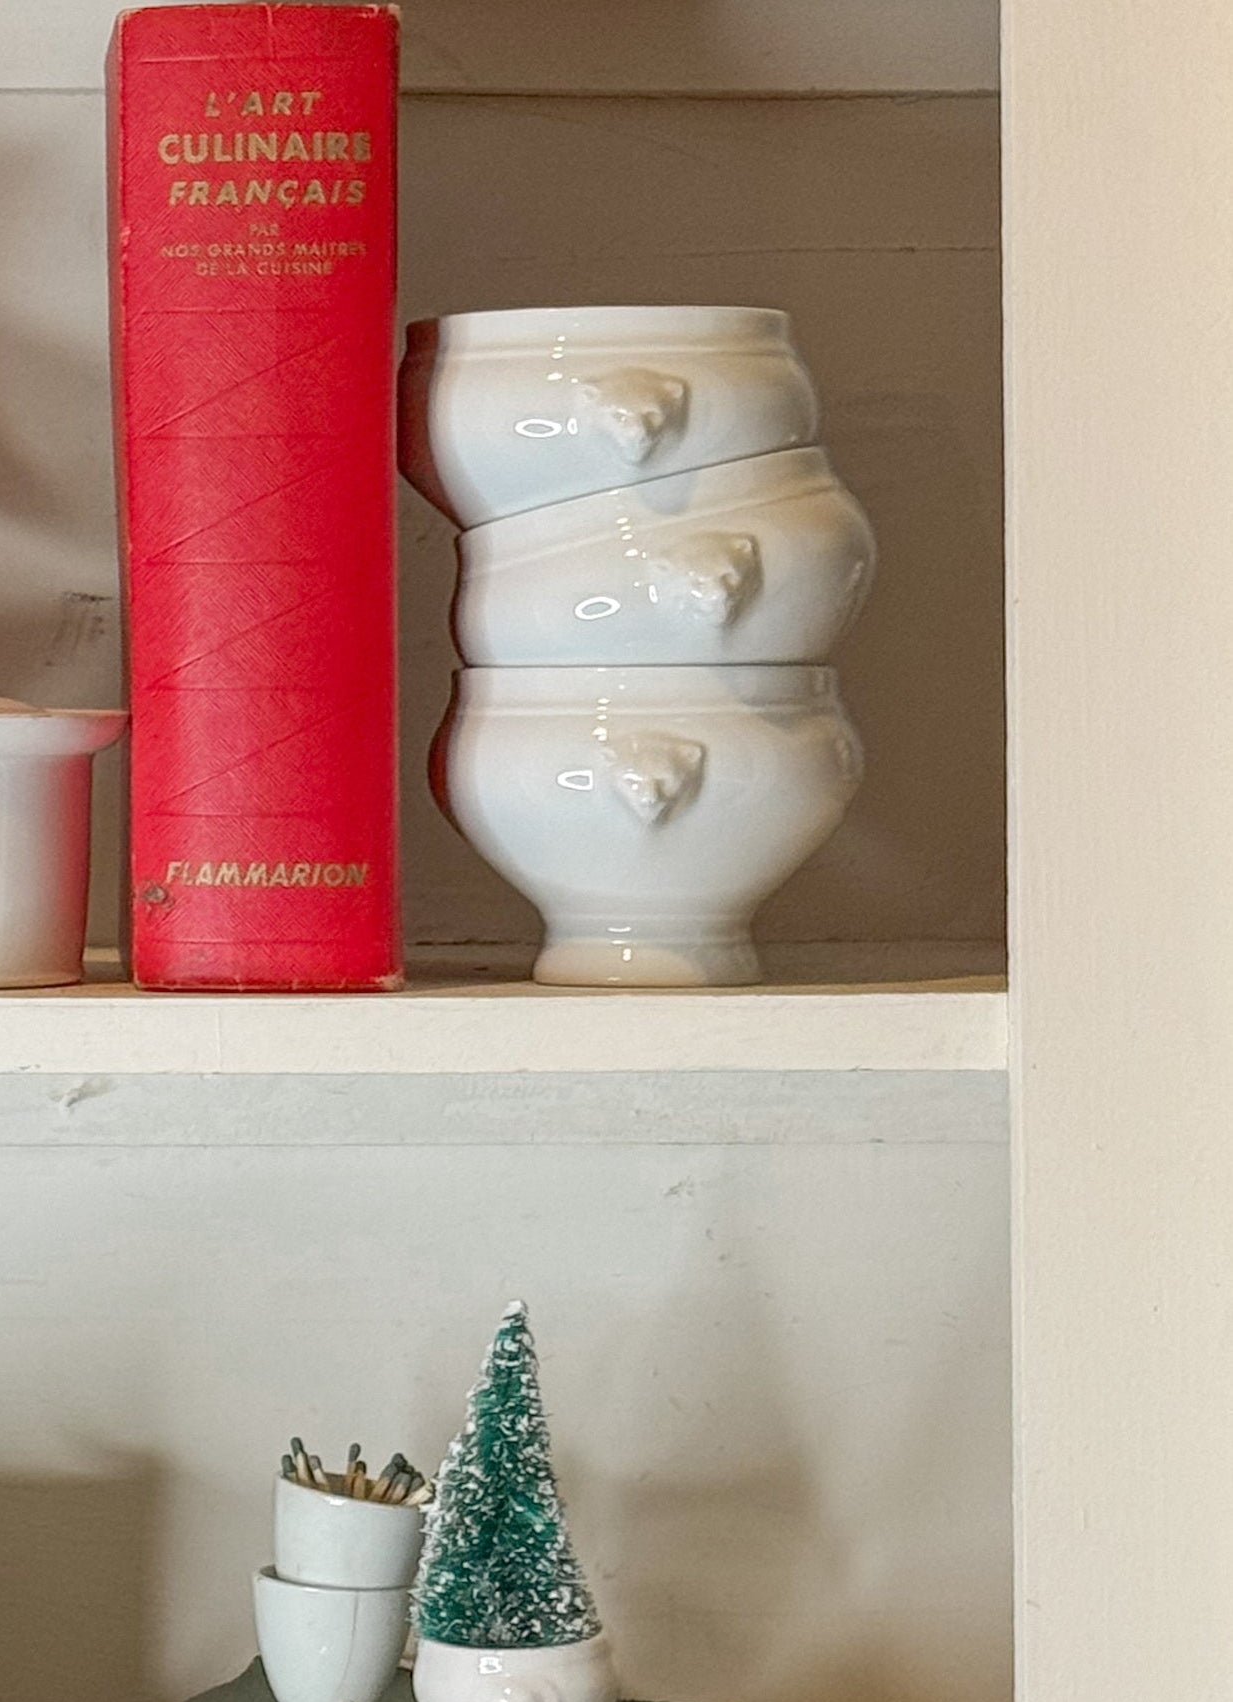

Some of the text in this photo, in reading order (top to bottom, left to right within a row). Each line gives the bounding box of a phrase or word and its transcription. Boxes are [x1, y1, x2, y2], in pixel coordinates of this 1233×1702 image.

[205, 91, 322, 118] L'ART
[157, 131, 372, 164] CULINAIRE
[168, 179, 367, 210] FRANÇAIS
[248, 223, 280, 237] PAR
[162, 244, 201, 258] NOS
[208, 242, 285, 258] GRANDS
[195, 261, 334, 276] DE LA CUISINE
[166, 861, 369, 887] FLAMMARION
